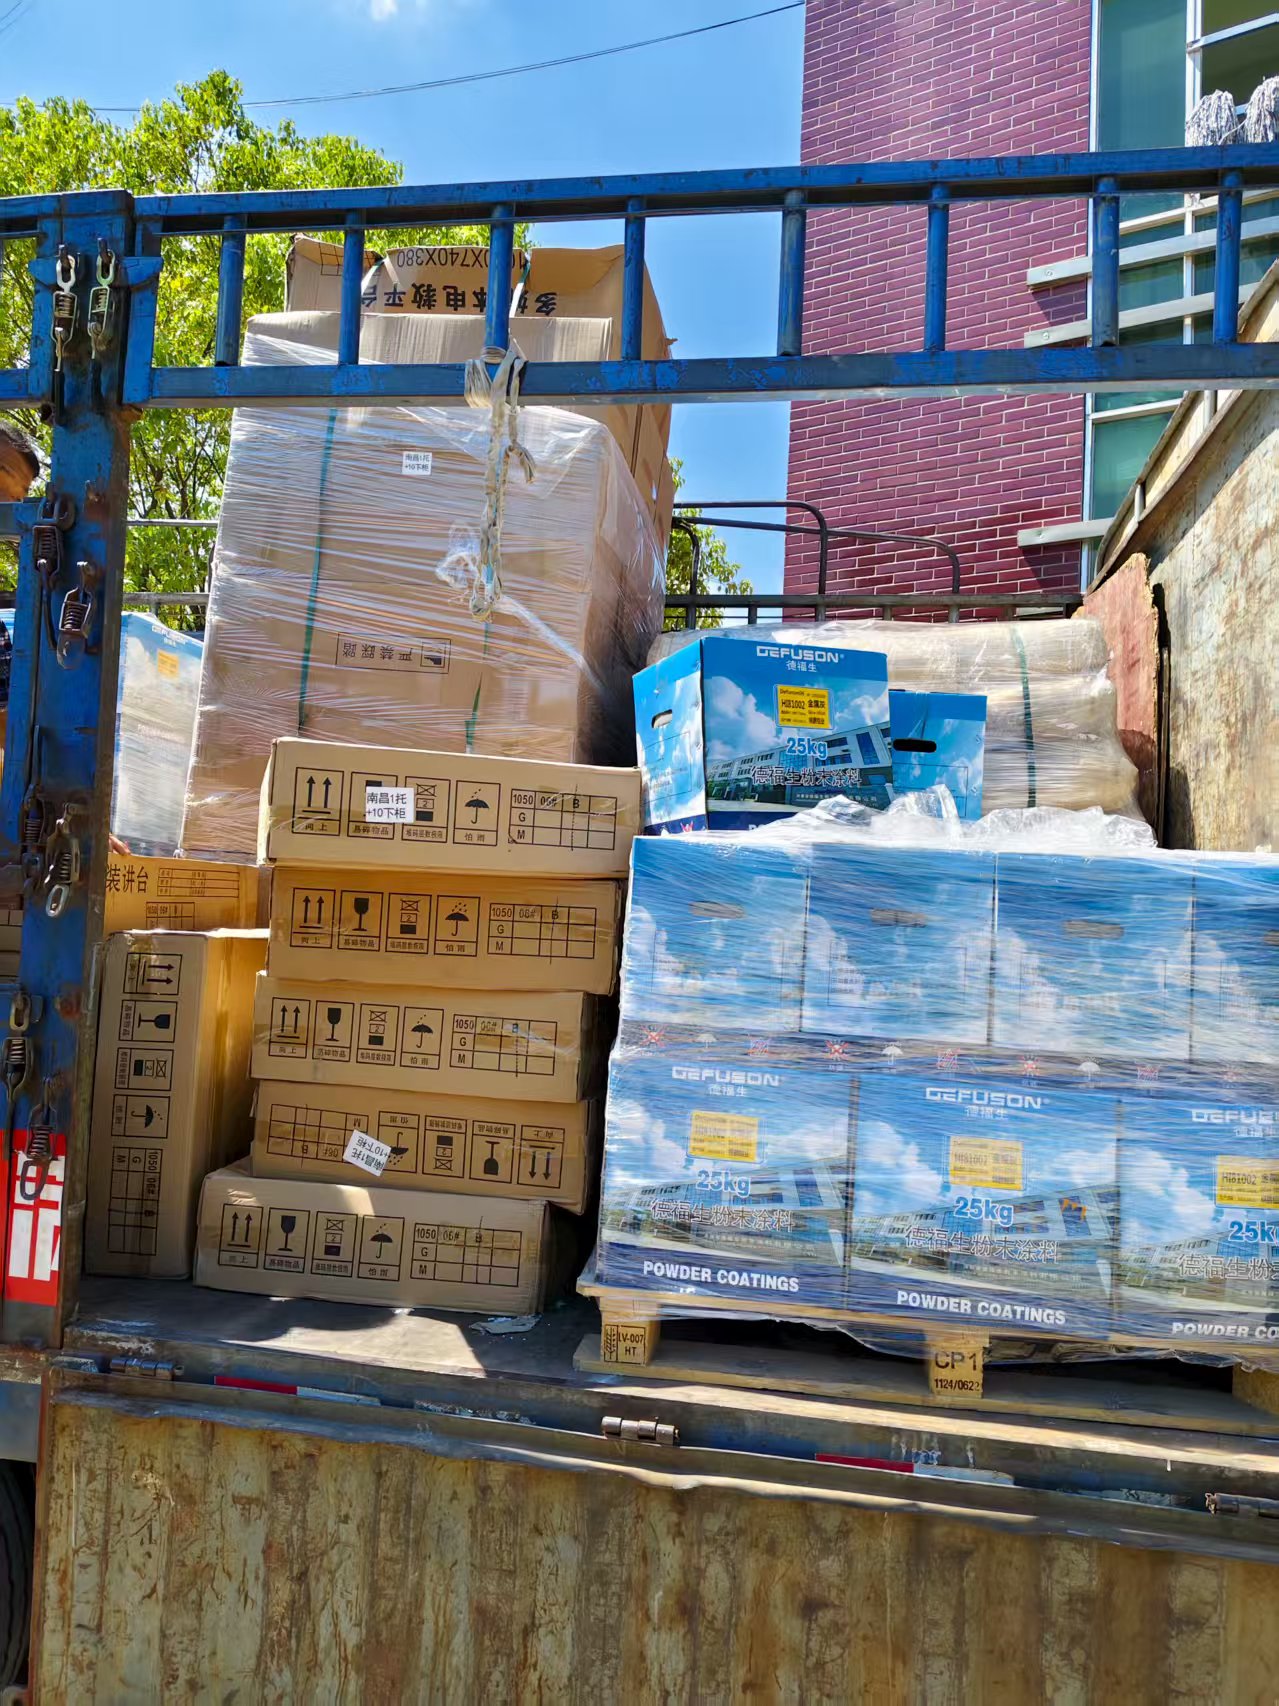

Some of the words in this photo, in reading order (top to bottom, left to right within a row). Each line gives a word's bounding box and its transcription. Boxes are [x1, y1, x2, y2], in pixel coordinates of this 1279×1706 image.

[398, 248, 524, 270] 1X740X380
[343, 643, 412, 661] 严禁踩踏
[757, 645, 839, 663] GEFUSON
[786, 660, 817, 672] 德福生
[786, 737, 828, 760] 25kg
[751, 765, 863, 788] 德福生粉末涂料
[367, 792, 407, 805] 南昌1托
[512, 794, 533, 805] 1050
[367, 807, 406, 819] +10下柜
[518, 812, 526, 822] G
[517, 829, 526, 840] M
[106, 863, 149, 893] 装讲台
[492, 907, 512, 917] 1050
[497, 924, 505, 935] G
[496, 941, 504, 951] M
[455, 1019, 474, 1030] 1050
[459, 1037, 467, 1047] G
[458, 1054, 466, 1064] M
[672, 1066, 780, 1086] GEFUSON
[925, 1087, 1041, 1109] GEFUSON
[353, 1118, 361, 1127] M
[132, 1156, 141, 1164] G
[695, 1169, 750, 1198] 25kg
[650, 1198, 796, 1233] 德福生粉末涂料
[953, 1196, 1014, 1227] 25kg
[416, 1227, 436, 1240] 1050
[905, 1224, 1060, 1264] 德福生粉末涂料
[420, 1247, 428, 1257] G
[418, 1264, 427, 1275] M
[643, 1261, 712, 1283] POWDER
[717, 1270, 800, 1292] COATINGS
[897, 1291, 972, 1314] POWDER
[977, 1302, 1066, 1325] COATINGS
[1172, 1322, 1249, 1337] POWDER
[625, 1346, 637, 1357] HT
[935, 1351, 977, 1371] CP1
